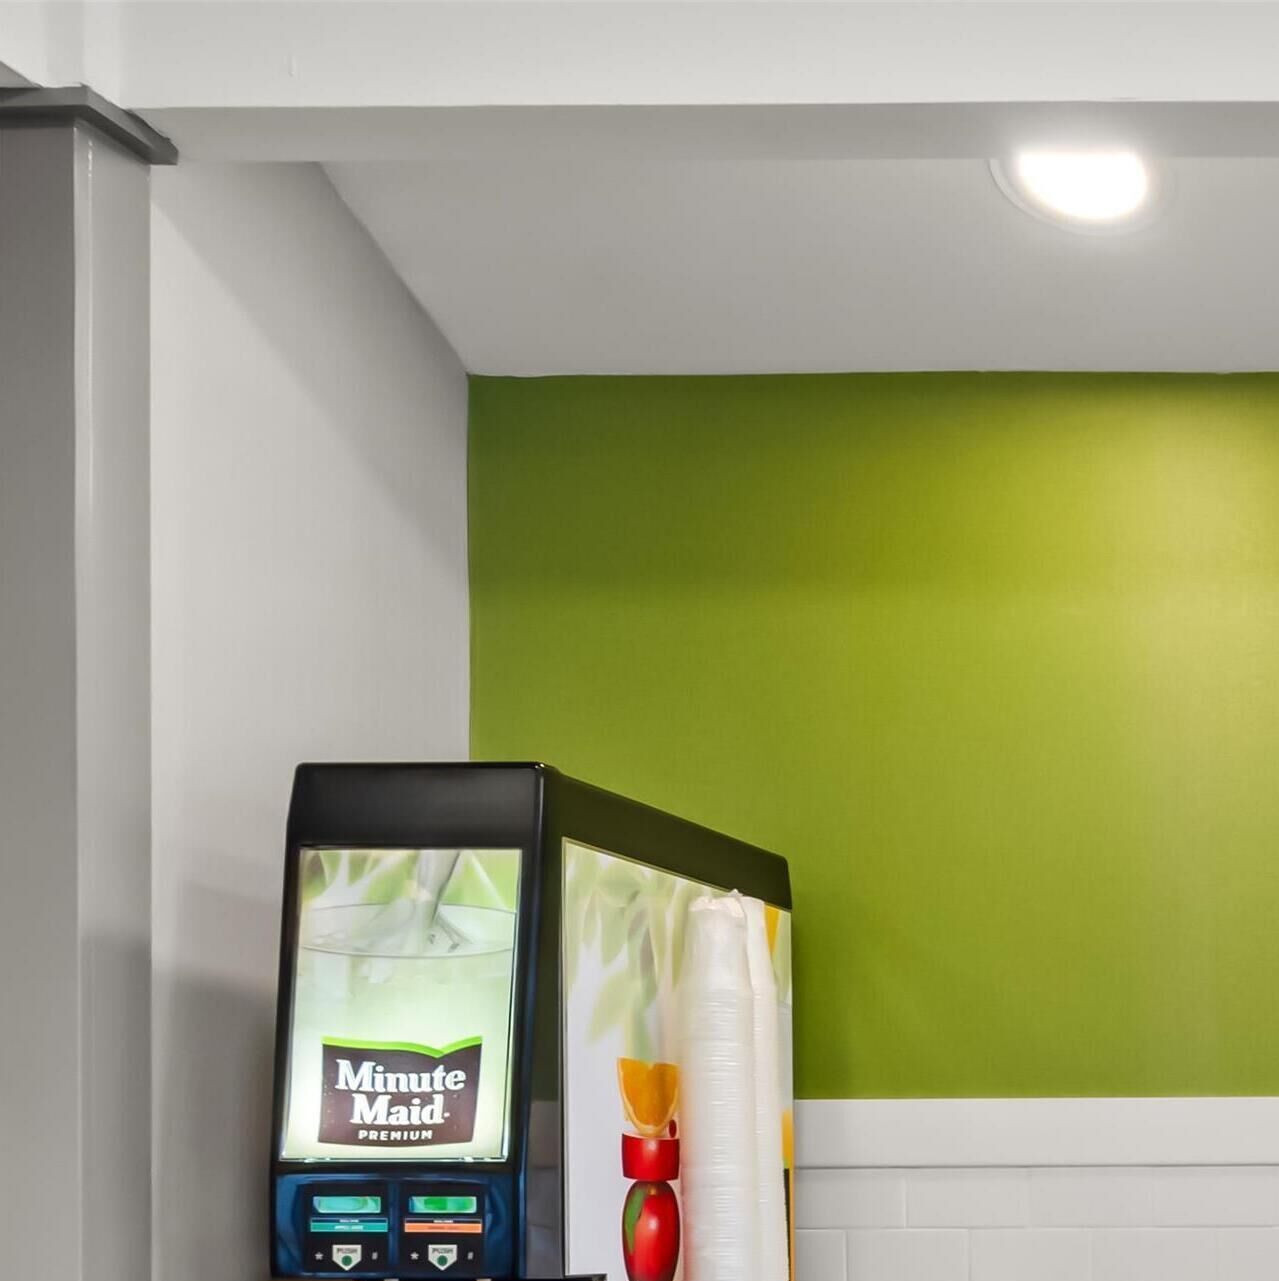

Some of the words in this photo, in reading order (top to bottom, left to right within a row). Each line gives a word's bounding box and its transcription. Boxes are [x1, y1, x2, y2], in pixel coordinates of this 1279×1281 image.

[335, 1059, 467, 1093] Minute
[350, 1093, 445, 1126] Maid
[358, 1129, 433, 1141] PREMIUM
